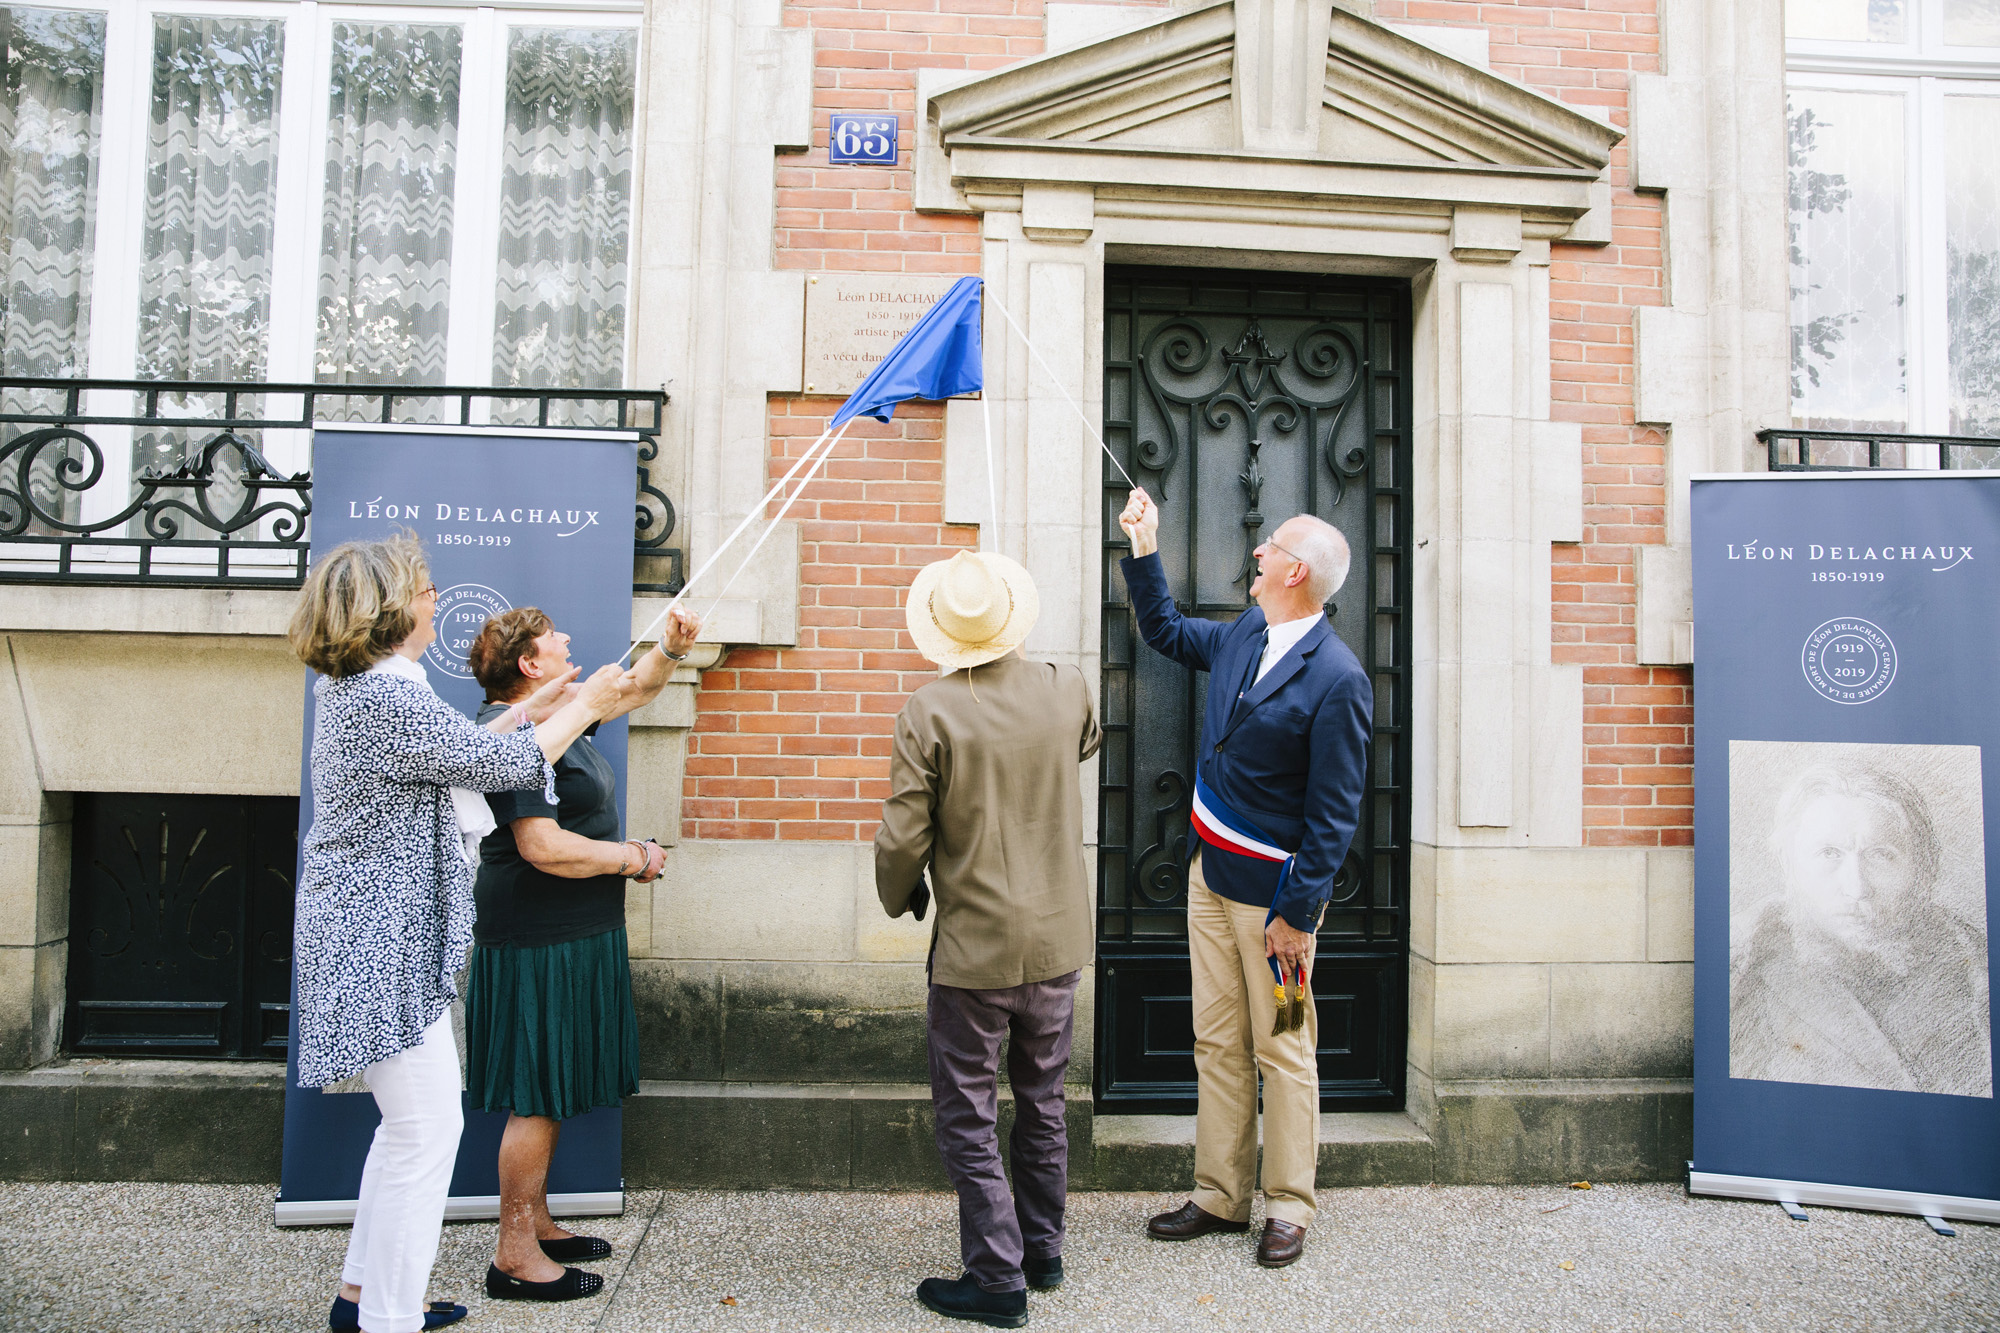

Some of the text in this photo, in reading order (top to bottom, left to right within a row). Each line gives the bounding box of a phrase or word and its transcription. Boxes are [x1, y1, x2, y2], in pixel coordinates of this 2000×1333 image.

[837, 120, 890, 156] 65
[837, 290, 944, 304] Léon DELACHAU
[867, 311, 889, 320] 1850
[899, 311, 922, 321] 1919
[854, 328, 909, 340] artiste pei
[823, 353, 830, 361] a
[833, 351, 858, 361] vécu
[349, 496, 600, 537] LÉON DELACHAUX
[436, 534, 511, 546] 1850-1919
[1727, 539, 1974, 572] LÉON DELACHAUX
[1811, 572, 1885, 582] 1850-1919
[455, 590, 507, 616] DELACHAU
[455, 612, 485, 623] 1919
[453, 638, 476, 649] 201
[1834, 643, 1864, 653] 1919
[430, 641, 445, 661] MOR
[446, 659, 458, 670] LA
[1808, 623, 1891, 699] CENTENAIRE DE LA MORT DE LÉON DELACHAUX
[1834, 667, 1866, 677] 2019
